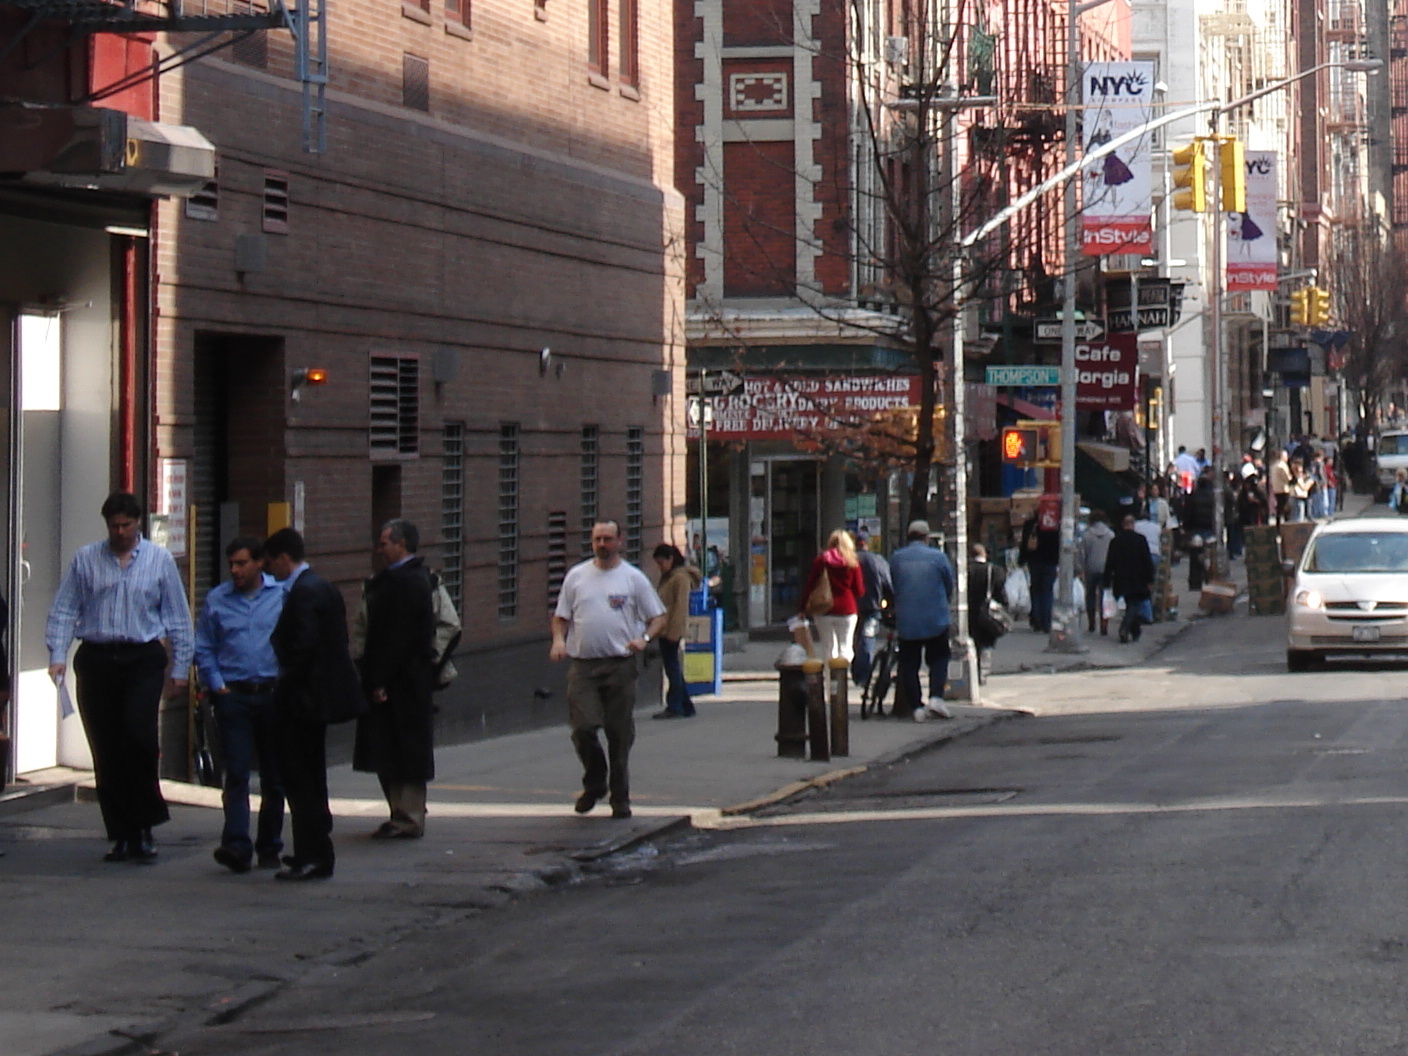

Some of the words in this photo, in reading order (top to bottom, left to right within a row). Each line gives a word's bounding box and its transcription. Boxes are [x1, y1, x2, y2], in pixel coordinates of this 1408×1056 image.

[1090, 76, 1144, 96] NYC
[1245, 159, 1270, 175] YC
[1083, 228, 1150, 244] InStyle
[1109, 312, 1166, 328] HANNAH
[1076, 326, 1096, 336] WAY
[1075, 345, 1121, 362] Cafe
[712, 378, 734, 391] WAY
[990, 369, 1049, 384] THOMPSON
[744, 381, 770, 395] HOT
[825, 378, 910, 393] SANDWICHES
[714, 393, 799, 411] GROCERY
[845, 396, 909, 411] PRODUCTS
[716, 419, 746, 432] FREE
